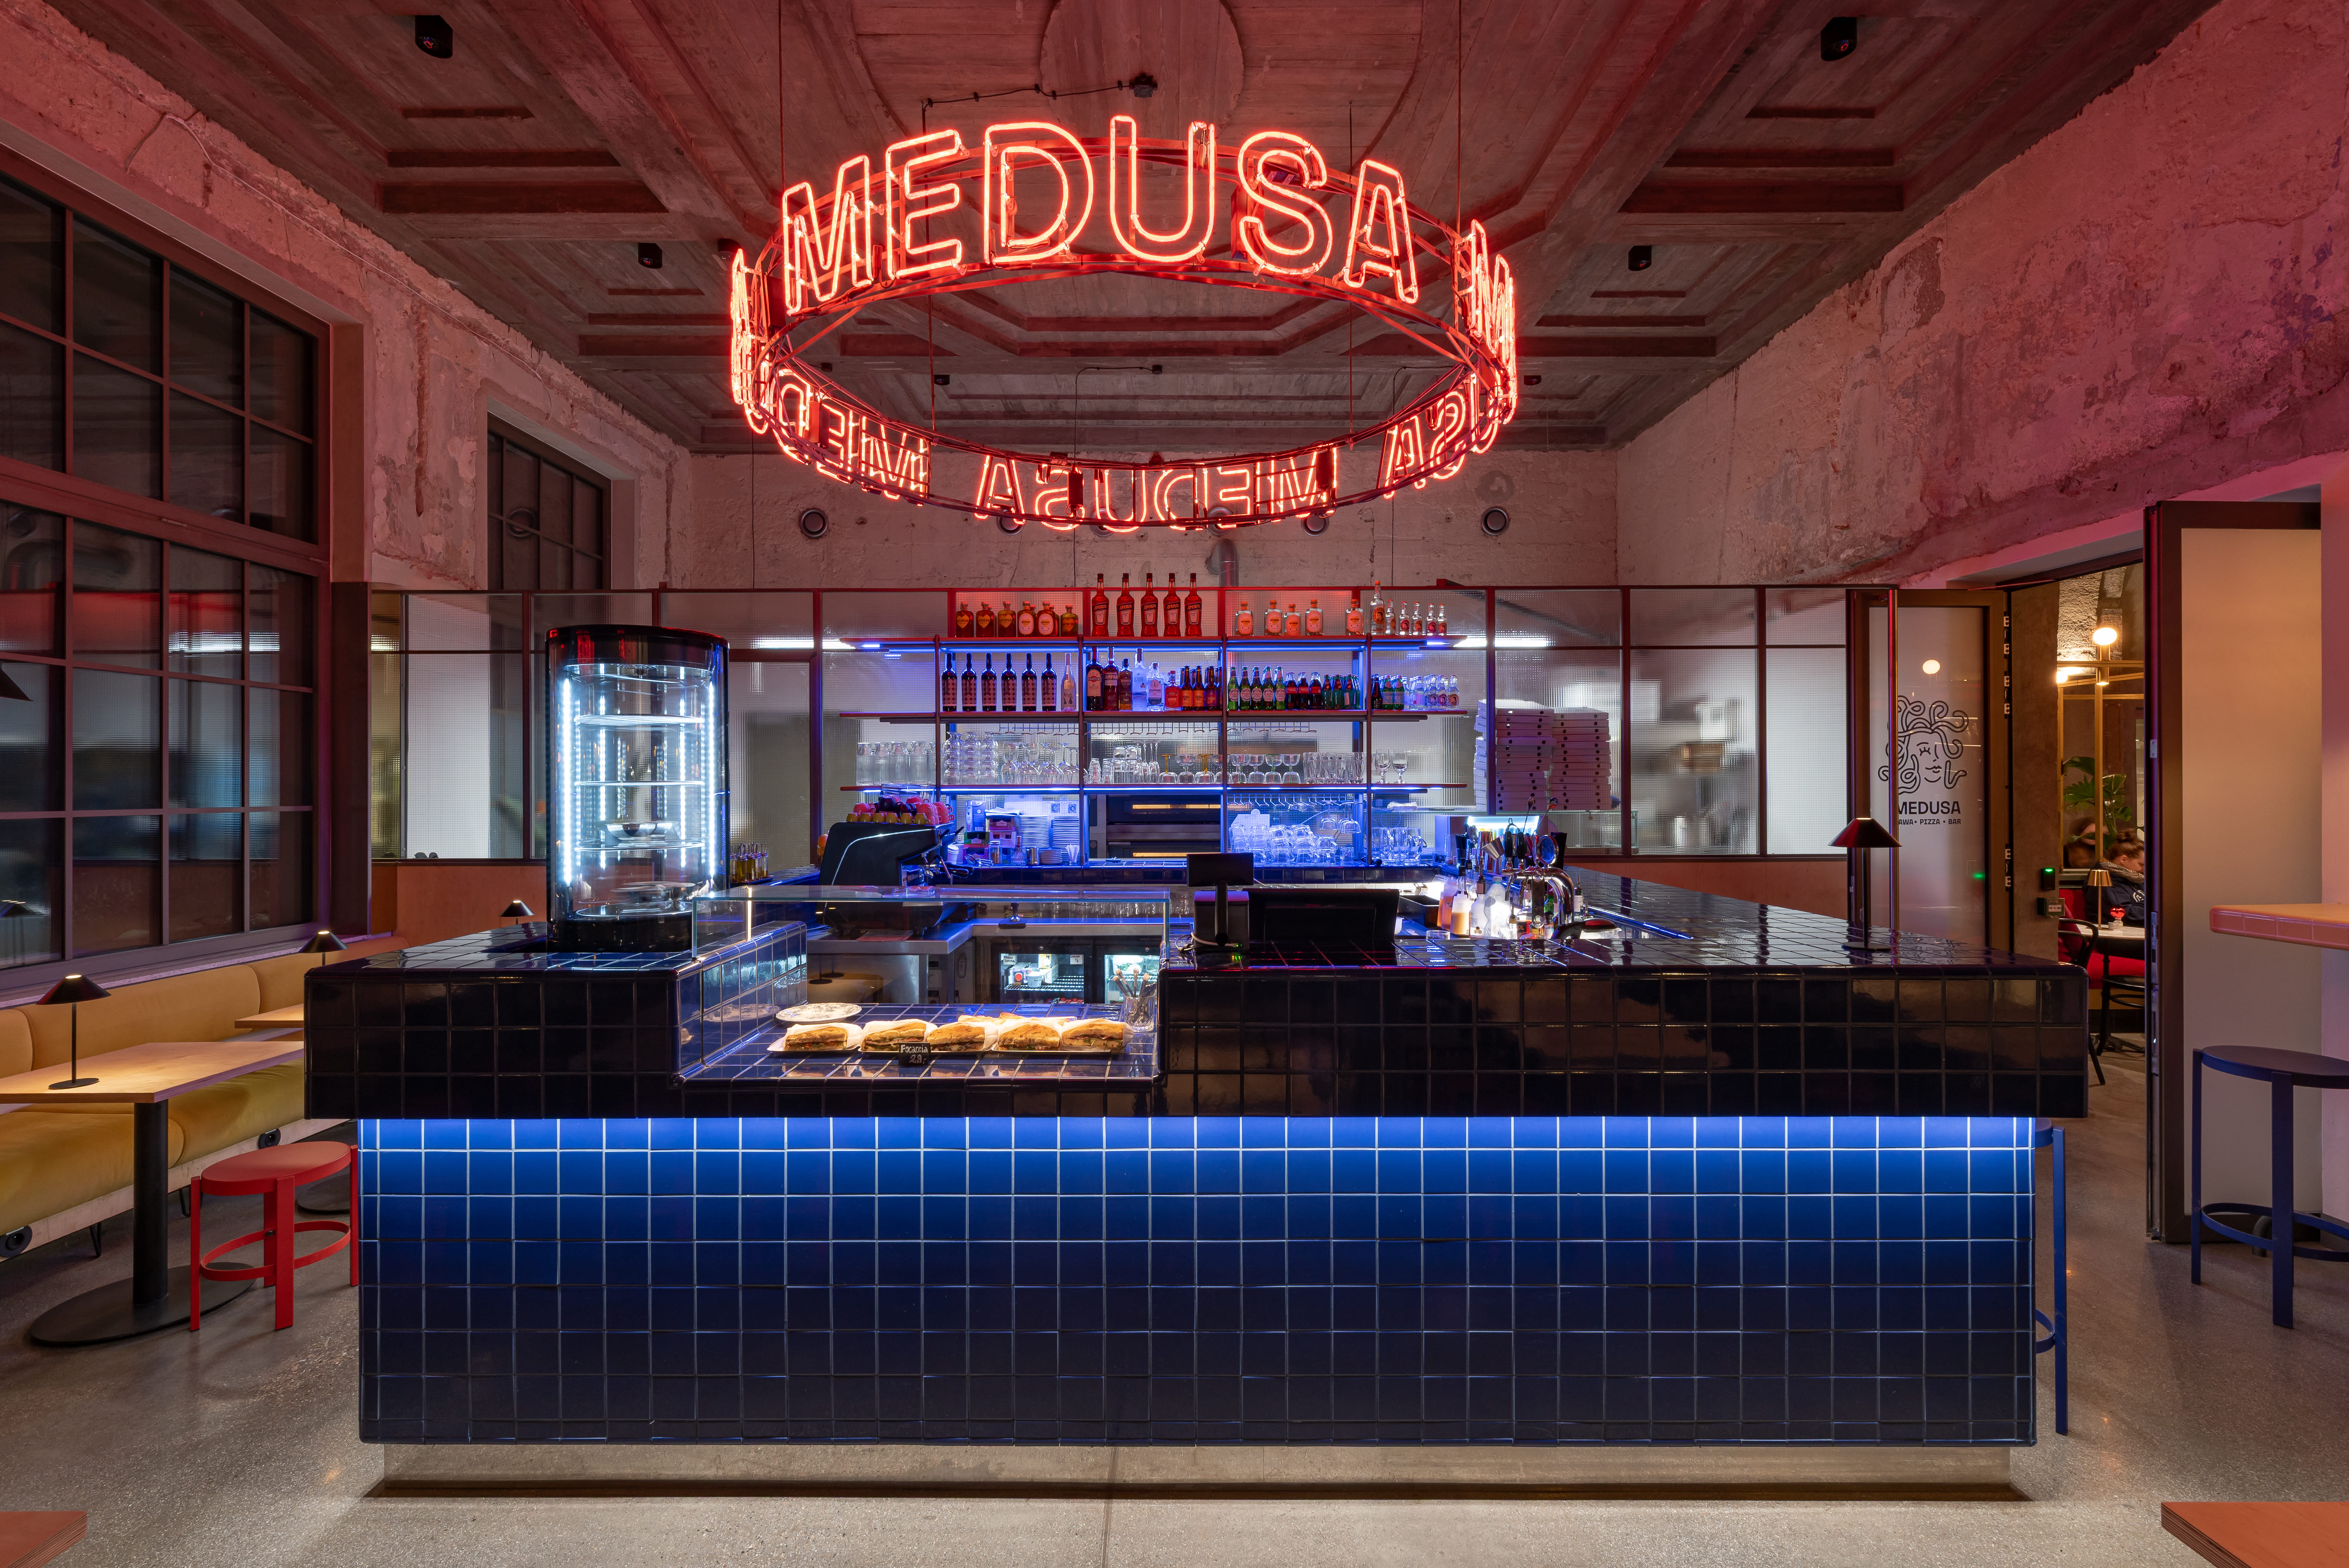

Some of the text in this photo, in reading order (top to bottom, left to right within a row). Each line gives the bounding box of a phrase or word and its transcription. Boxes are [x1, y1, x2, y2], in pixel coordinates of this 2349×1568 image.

[782, 114, 1419, 316] MEDUSA
[1898, 801, 1961, 814] MEDUSA
[900, 1044, 928, 1053] Focaccia
